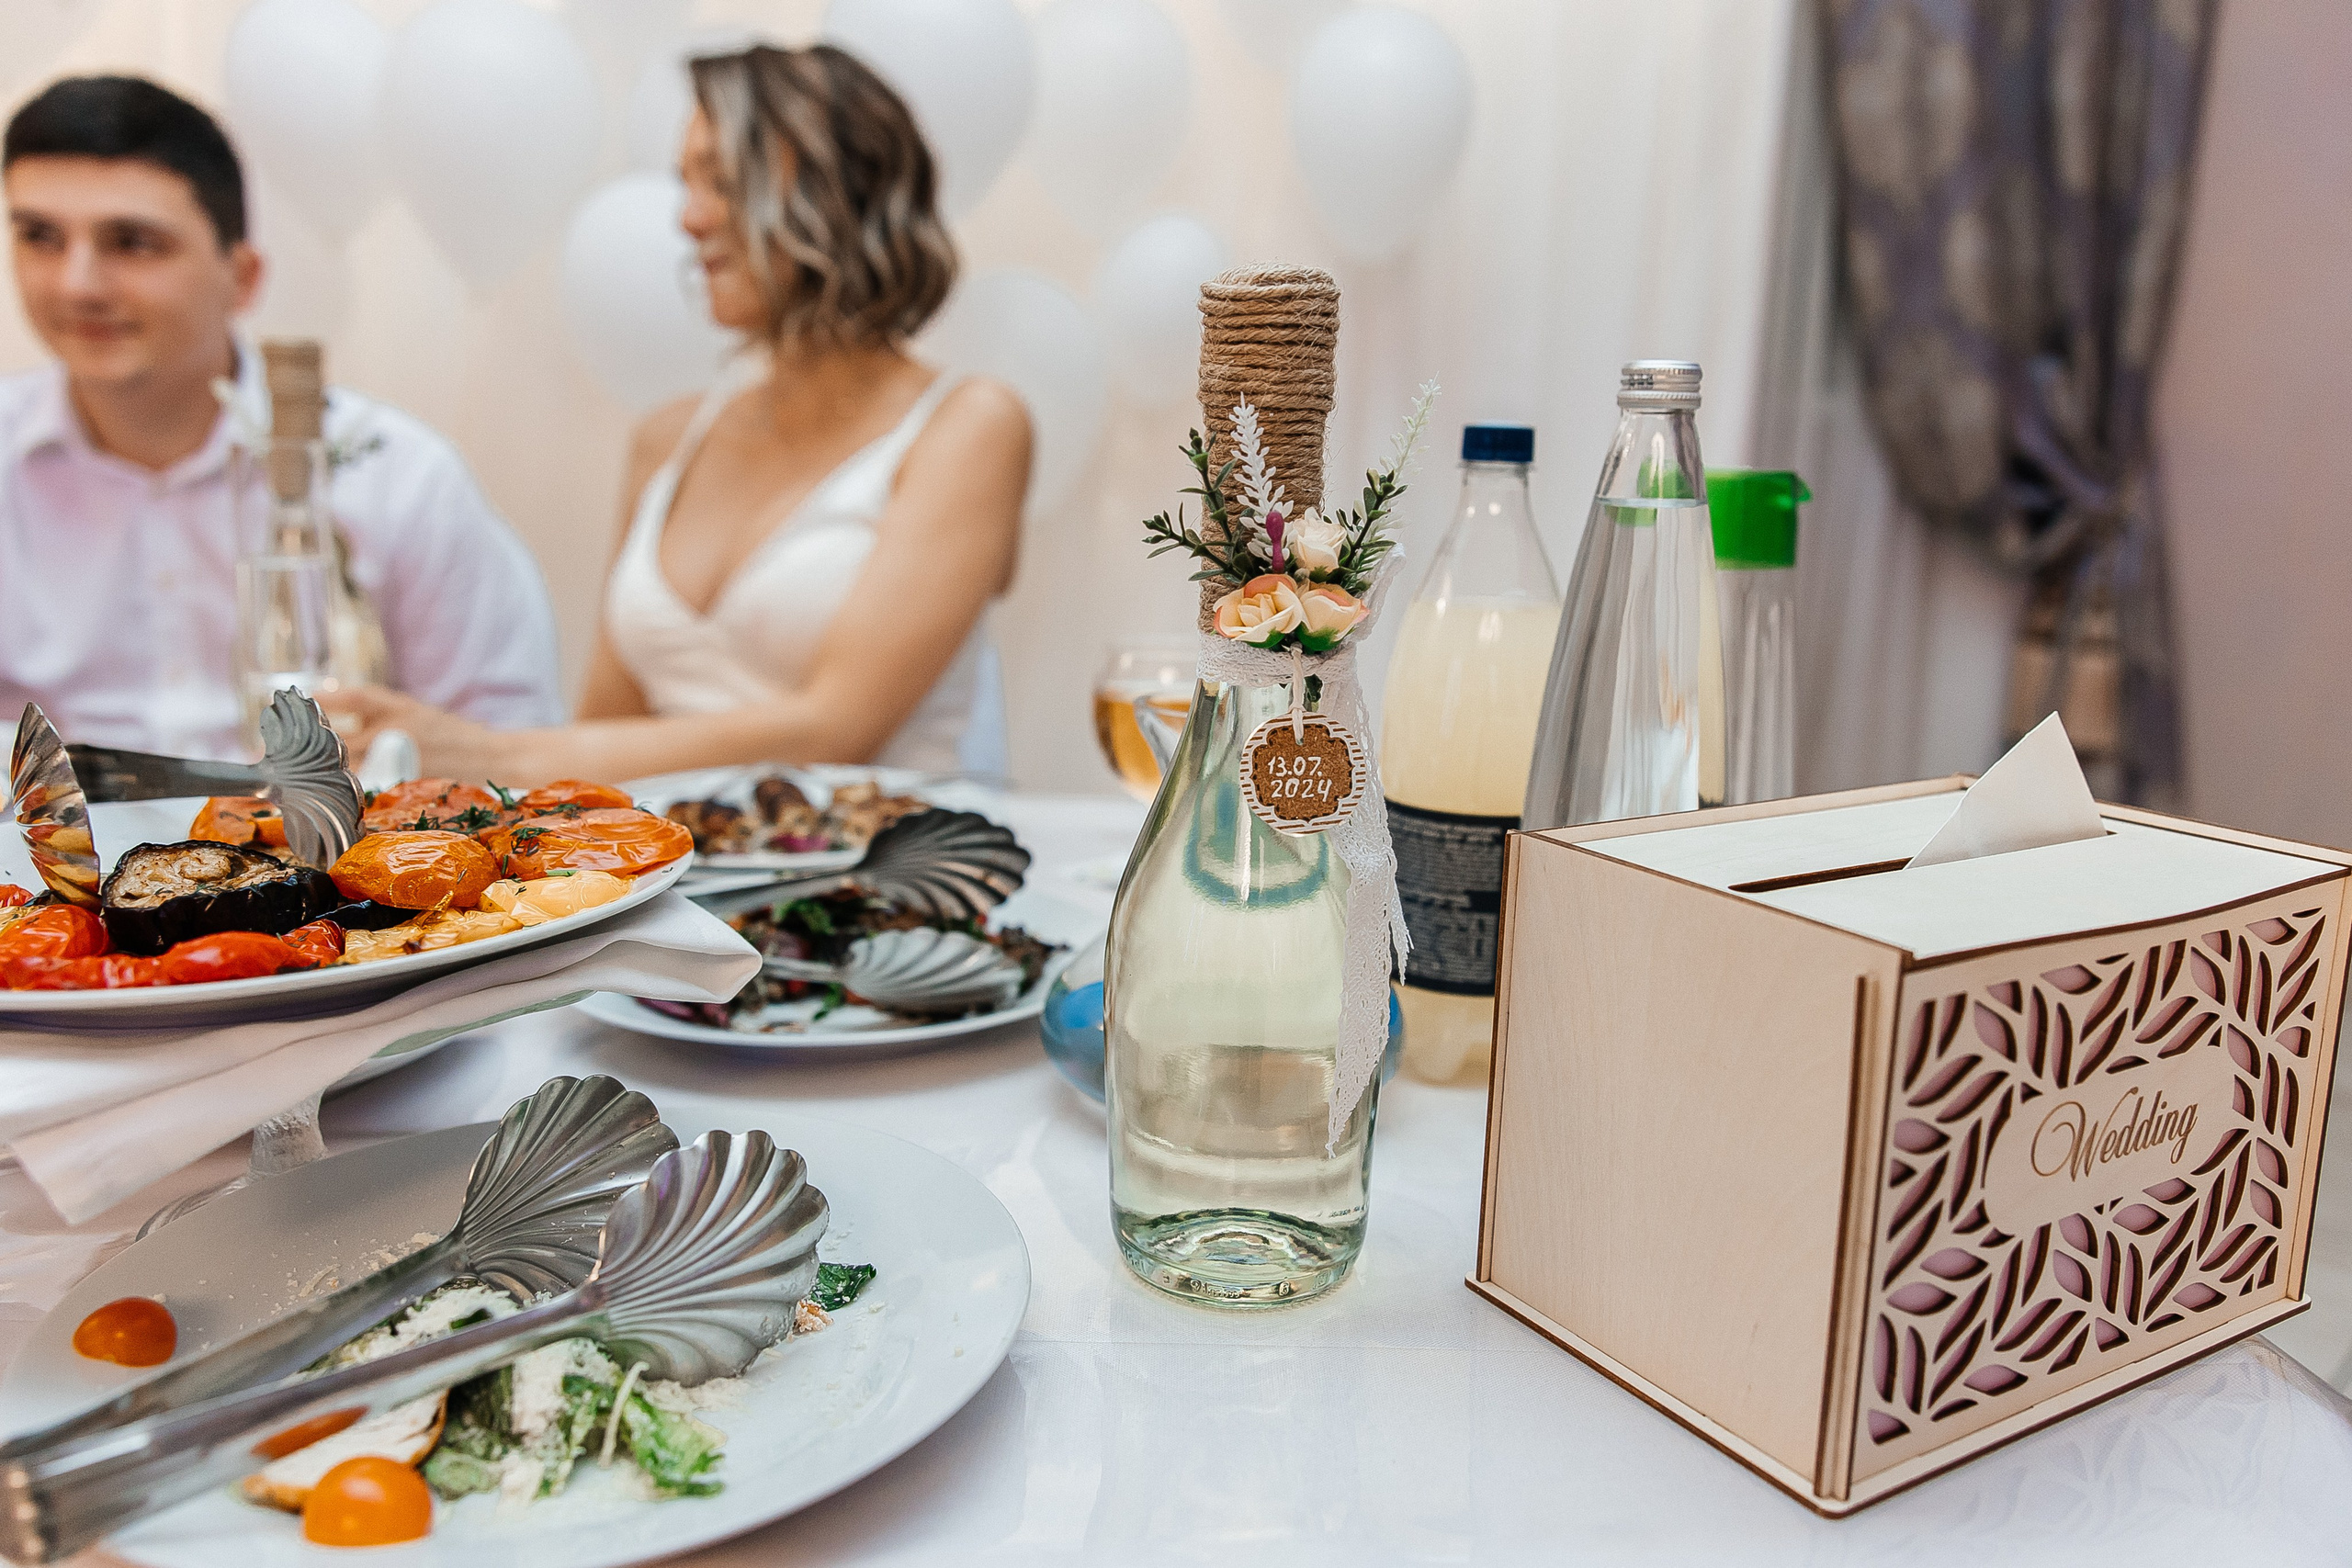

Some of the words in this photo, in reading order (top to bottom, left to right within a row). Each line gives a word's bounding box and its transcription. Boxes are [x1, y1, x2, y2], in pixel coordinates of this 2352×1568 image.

[1267, 756, 1323, 777] 13.07.
[1270, 777, 1332, 802] 2024
[2030, 1086, 2199, 1182] Wedding
